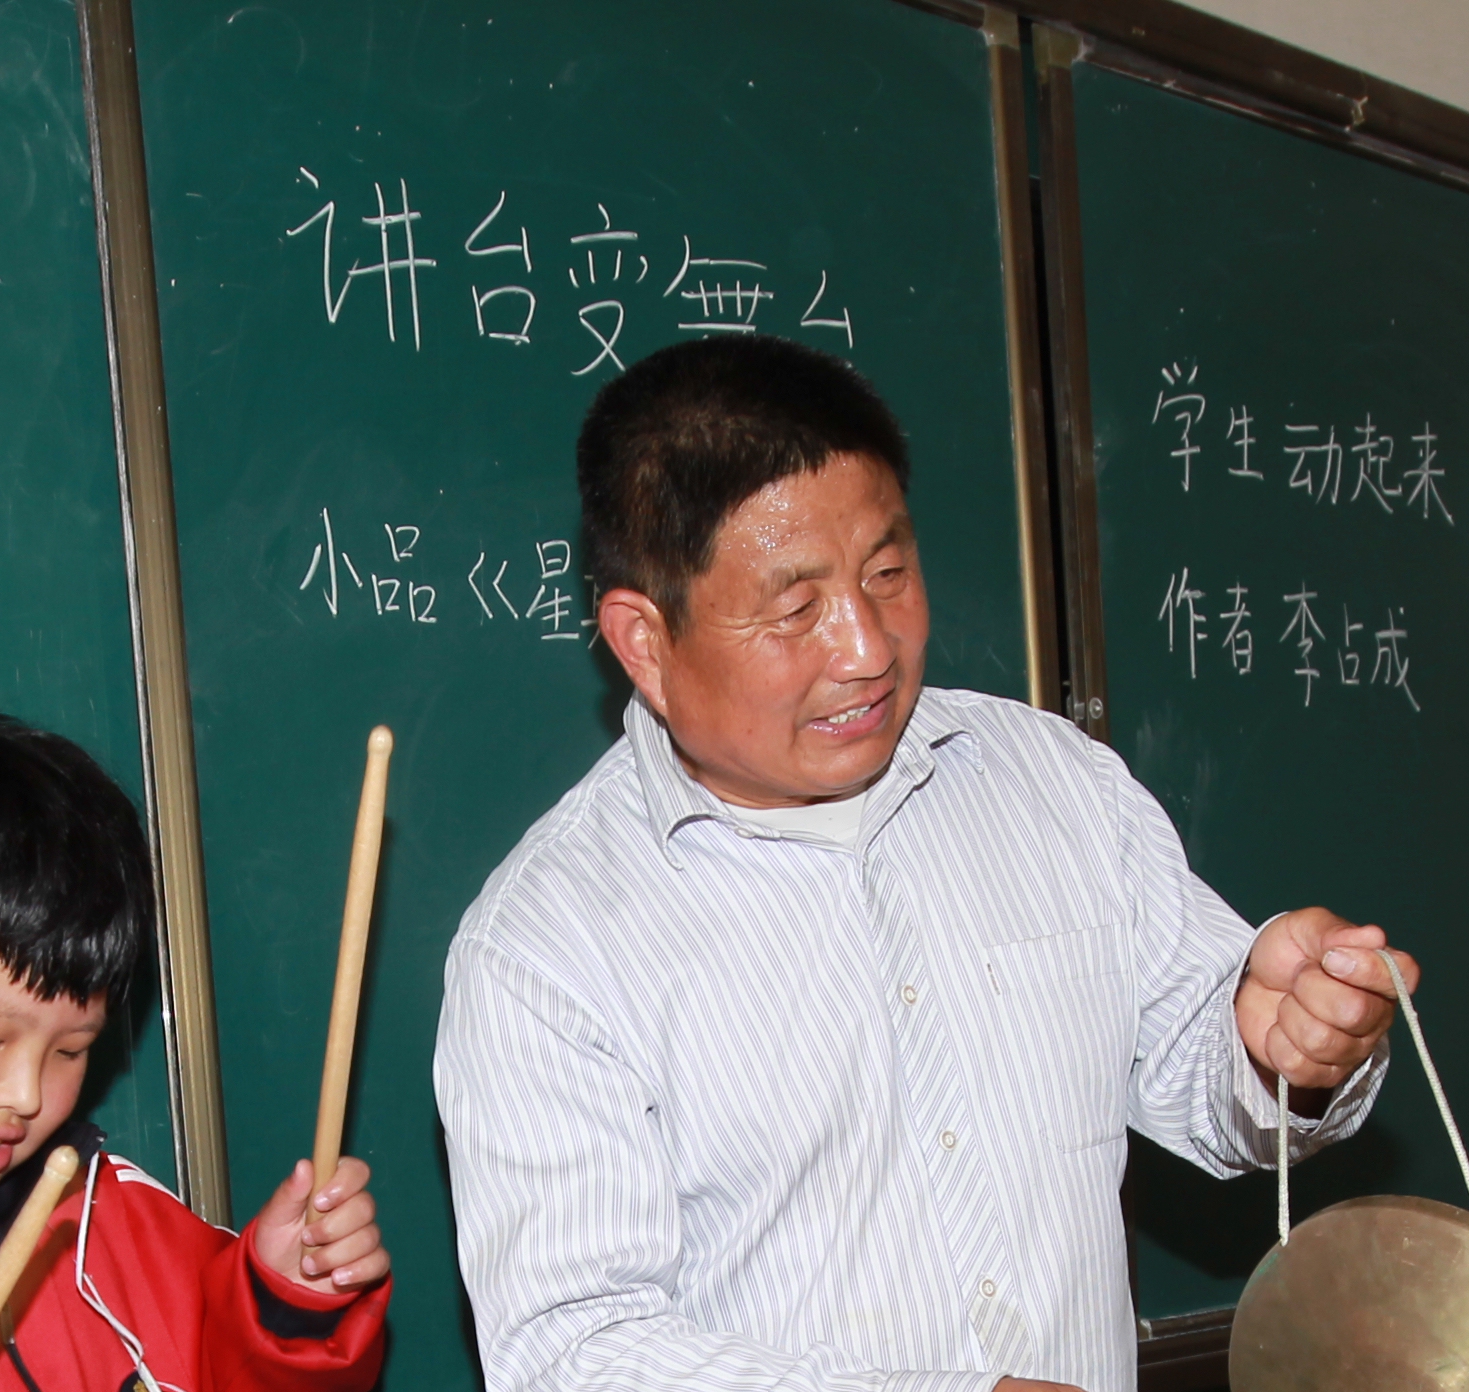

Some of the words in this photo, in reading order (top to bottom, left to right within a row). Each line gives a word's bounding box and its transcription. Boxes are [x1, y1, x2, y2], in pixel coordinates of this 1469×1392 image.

[1151, 361, 1455, 526] 学生动起来
[299, 506, 600, 651] 小品《星
